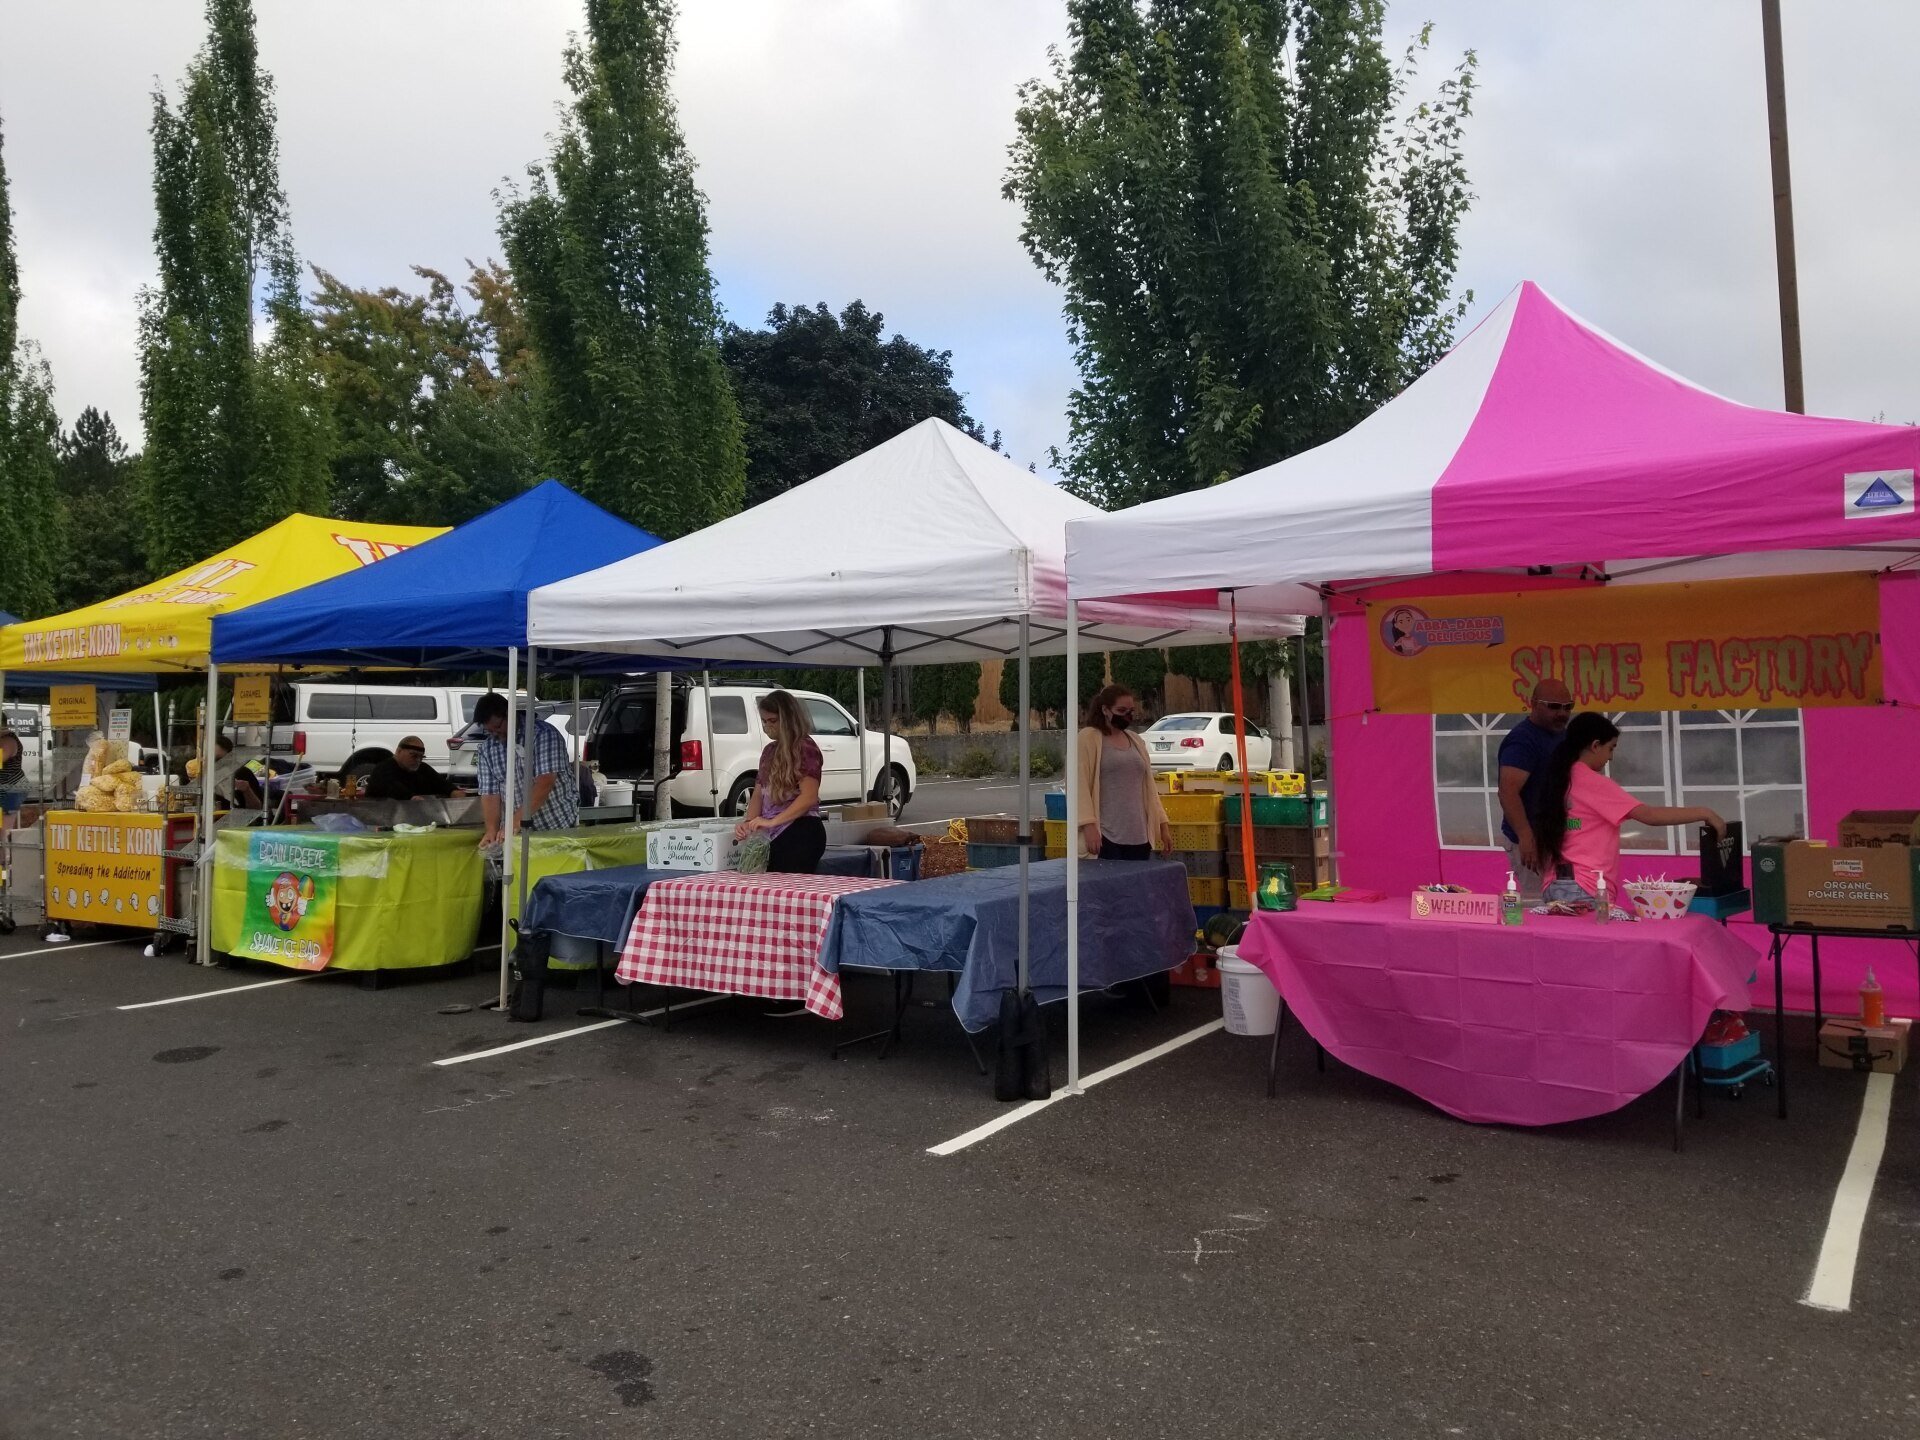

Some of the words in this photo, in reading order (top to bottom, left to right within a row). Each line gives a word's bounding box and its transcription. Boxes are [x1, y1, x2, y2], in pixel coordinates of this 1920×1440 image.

[1415, 617, 1502, 632] ABBA-DABBA
[23, 632, 43, 663] TNT
[44, 626, 87, 662] KETTLE
[87, 623, 121, 657] KORN
[1427, 630, 1492, 642] DELICIOUS
[1511, 643, 1643, 705] SLIME
[1666, 631, 1873, 702] FACTORY
[58, 696, 87, 706] ORIGINAL
[240, 689, 262, 699] CARAMEL
[50, 824, 72, 851] TNT
[77, 825, 120, 854] KETTLE
[126, 827, 162, 857] KORN
[663, 841, 700, 851] Northwest
[259, 840, 287, 865] BRAIN
[289, 845, 327, 869] FREEZE
[668, 851, 696, 861] Produce
[97, 864, 109, 878] the
[1823, 881, 1872, 890] ORGANIC
[1808, 890, 1845, 899] POWER
[1848, 891, 1889, 900] GREENS
[1431, 898, 1495, 917] WELCOME
[249, 931, 281, 955] SHAVE
[282, 939, 297, 958] ICE
